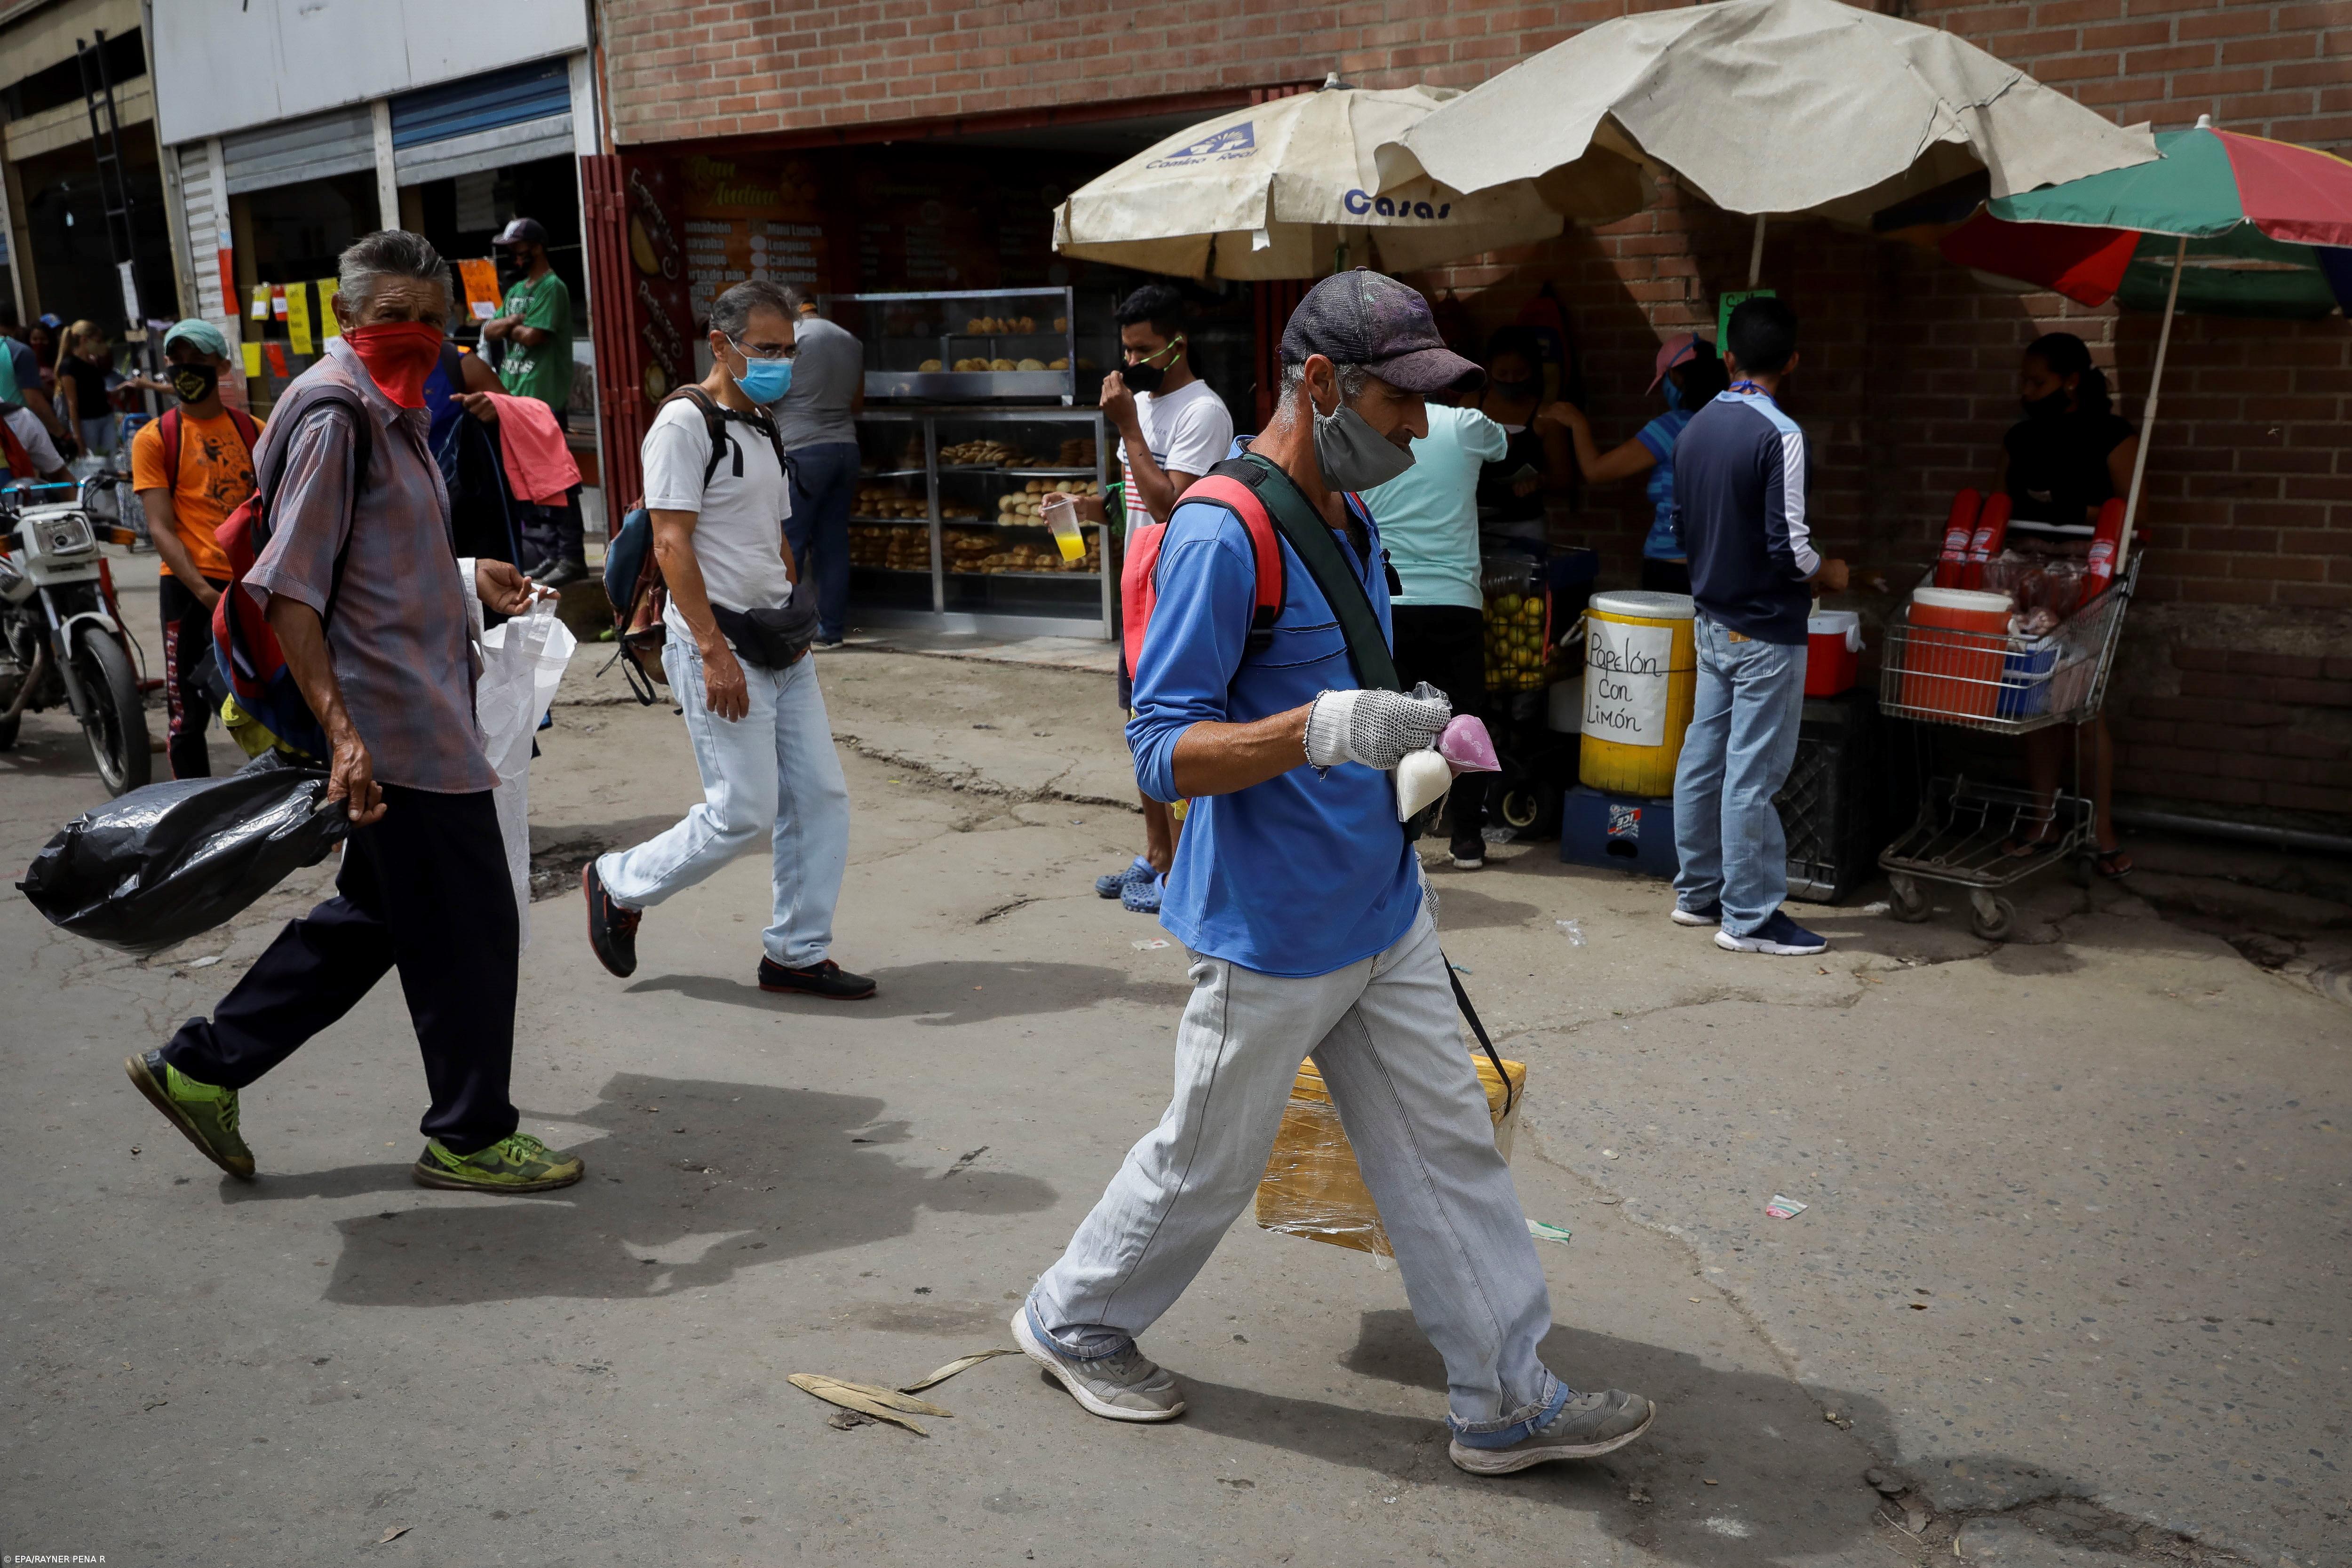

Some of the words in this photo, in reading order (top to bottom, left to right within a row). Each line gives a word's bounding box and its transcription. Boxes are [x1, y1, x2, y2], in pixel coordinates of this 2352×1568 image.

[1145, 157, 1207, 169] Camino
[1216, 148, 1260, 162] Real
[1344, 189, 1451, 219] Casas
[792, 224, 823, 237] Lunch
[725, 271, 746, 282] pan
[1589, 632, 1662, 678] Papelón
